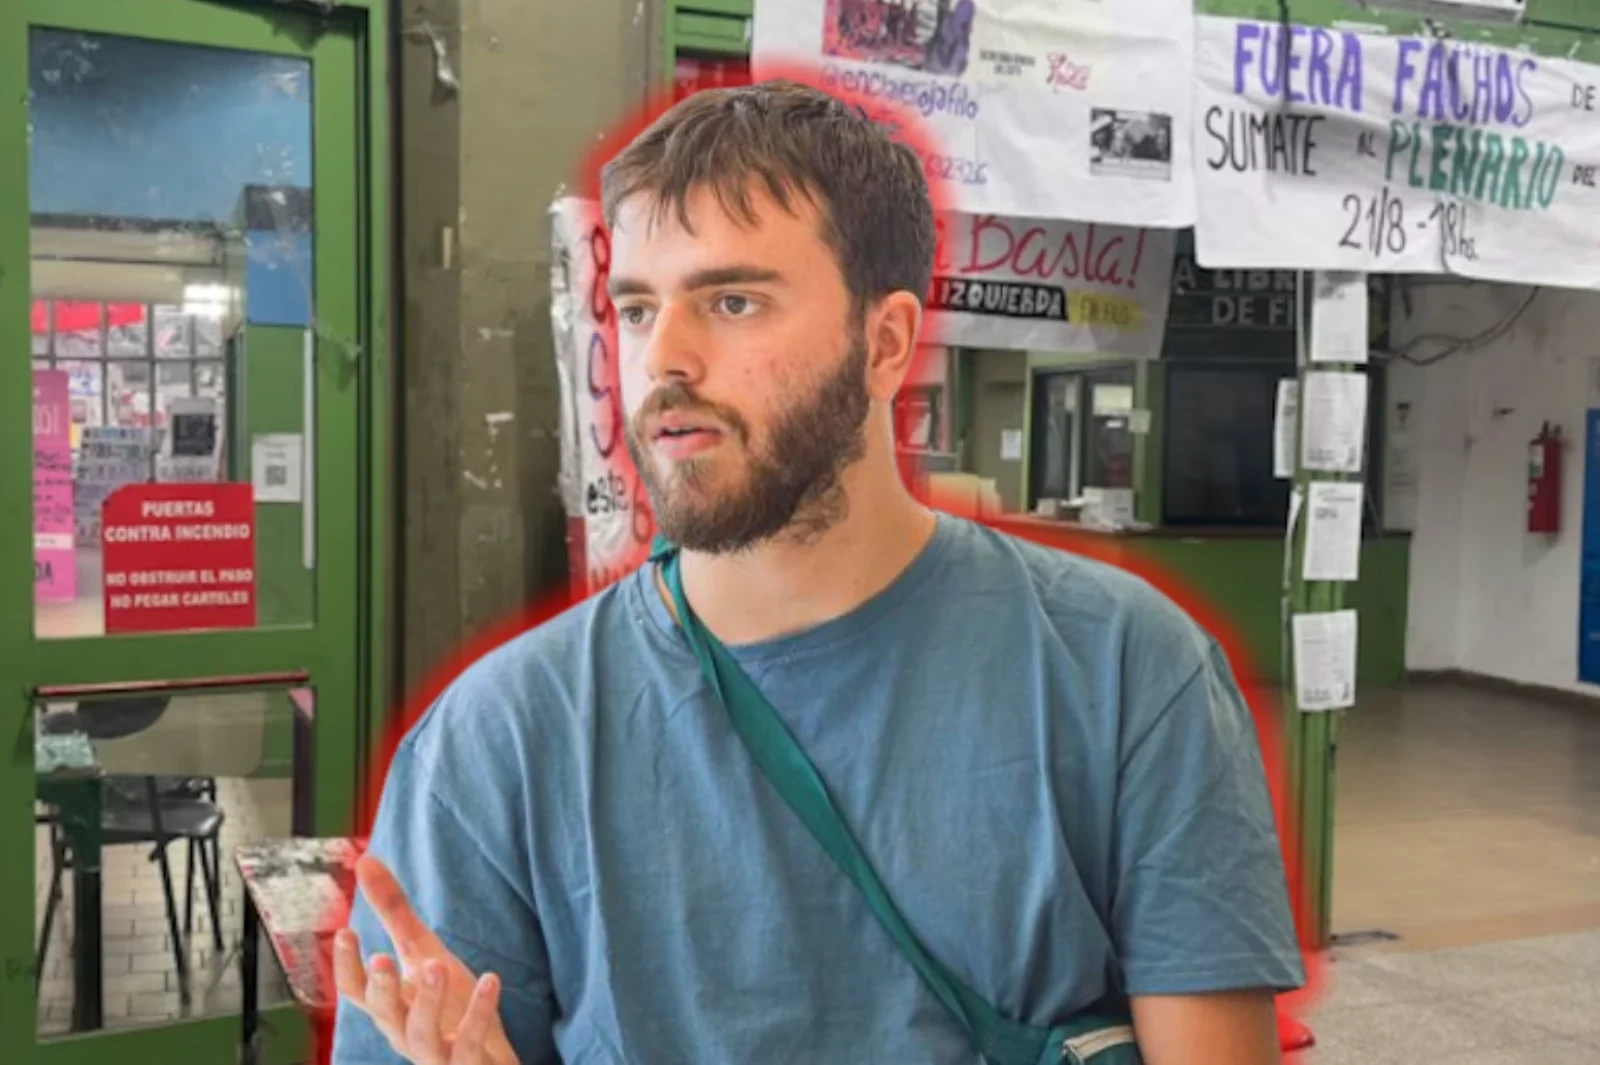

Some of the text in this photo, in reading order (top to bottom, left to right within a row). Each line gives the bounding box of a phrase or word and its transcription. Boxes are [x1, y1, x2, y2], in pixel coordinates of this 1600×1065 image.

[1234, 24, 1596, 128] FUERA FACHOS DE
[1205, 106, 1325, 177] SUMATE
[1385, 119, 1564, 210] PLENARIO
[1338, 186, 1407, 258] 21/8
[1211, 296, 1255, 326] DE
[141, 500, 215, 518] PUERTAS
[104, 523, 251, 542] CONTRA INCENDIO
[106, 568, 253, 586] NO OBSTRUIR EL PASO
[110, 590, 250, 609] NO PEGAR CARTELES
